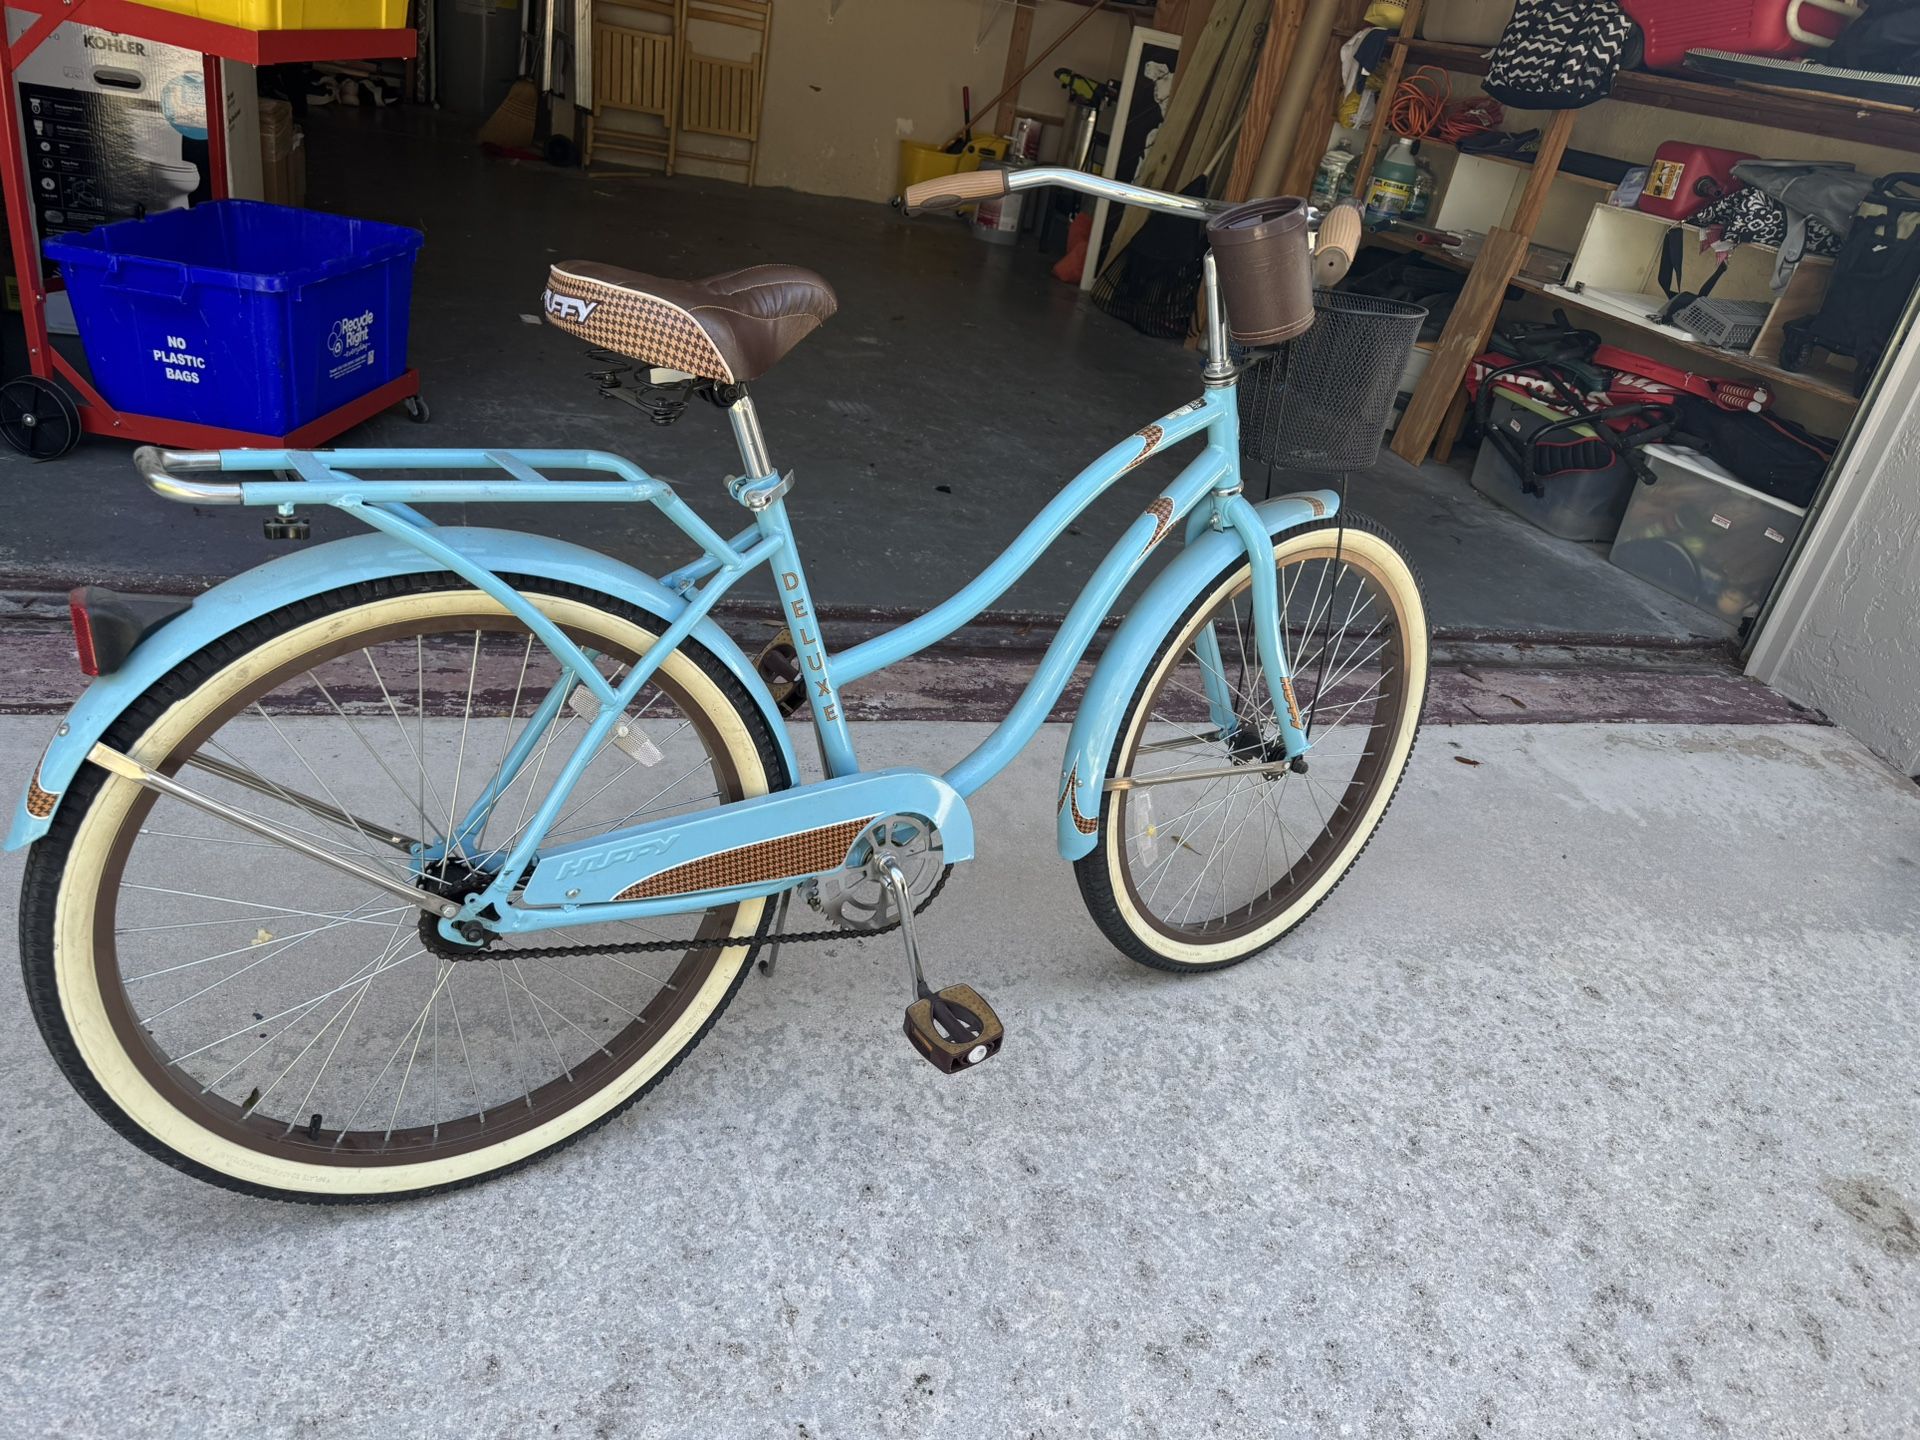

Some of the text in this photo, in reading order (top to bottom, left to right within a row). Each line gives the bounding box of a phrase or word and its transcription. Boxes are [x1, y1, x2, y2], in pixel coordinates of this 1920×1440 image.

[84, 34, 146, 57] KOHLER
[544, 288, 600, 323] UFFY
[342, 309, 374, 335] Recycle
[167, 335, 187, 350] NO
[346, 326, 369, 348] Right
[153, 349, 206, 369] PLASTIC
[165, 367, 200, 384] BAGS
[781, 571, 839, 722] DELUXE
[555, 833, 681, 881] HUFFY
